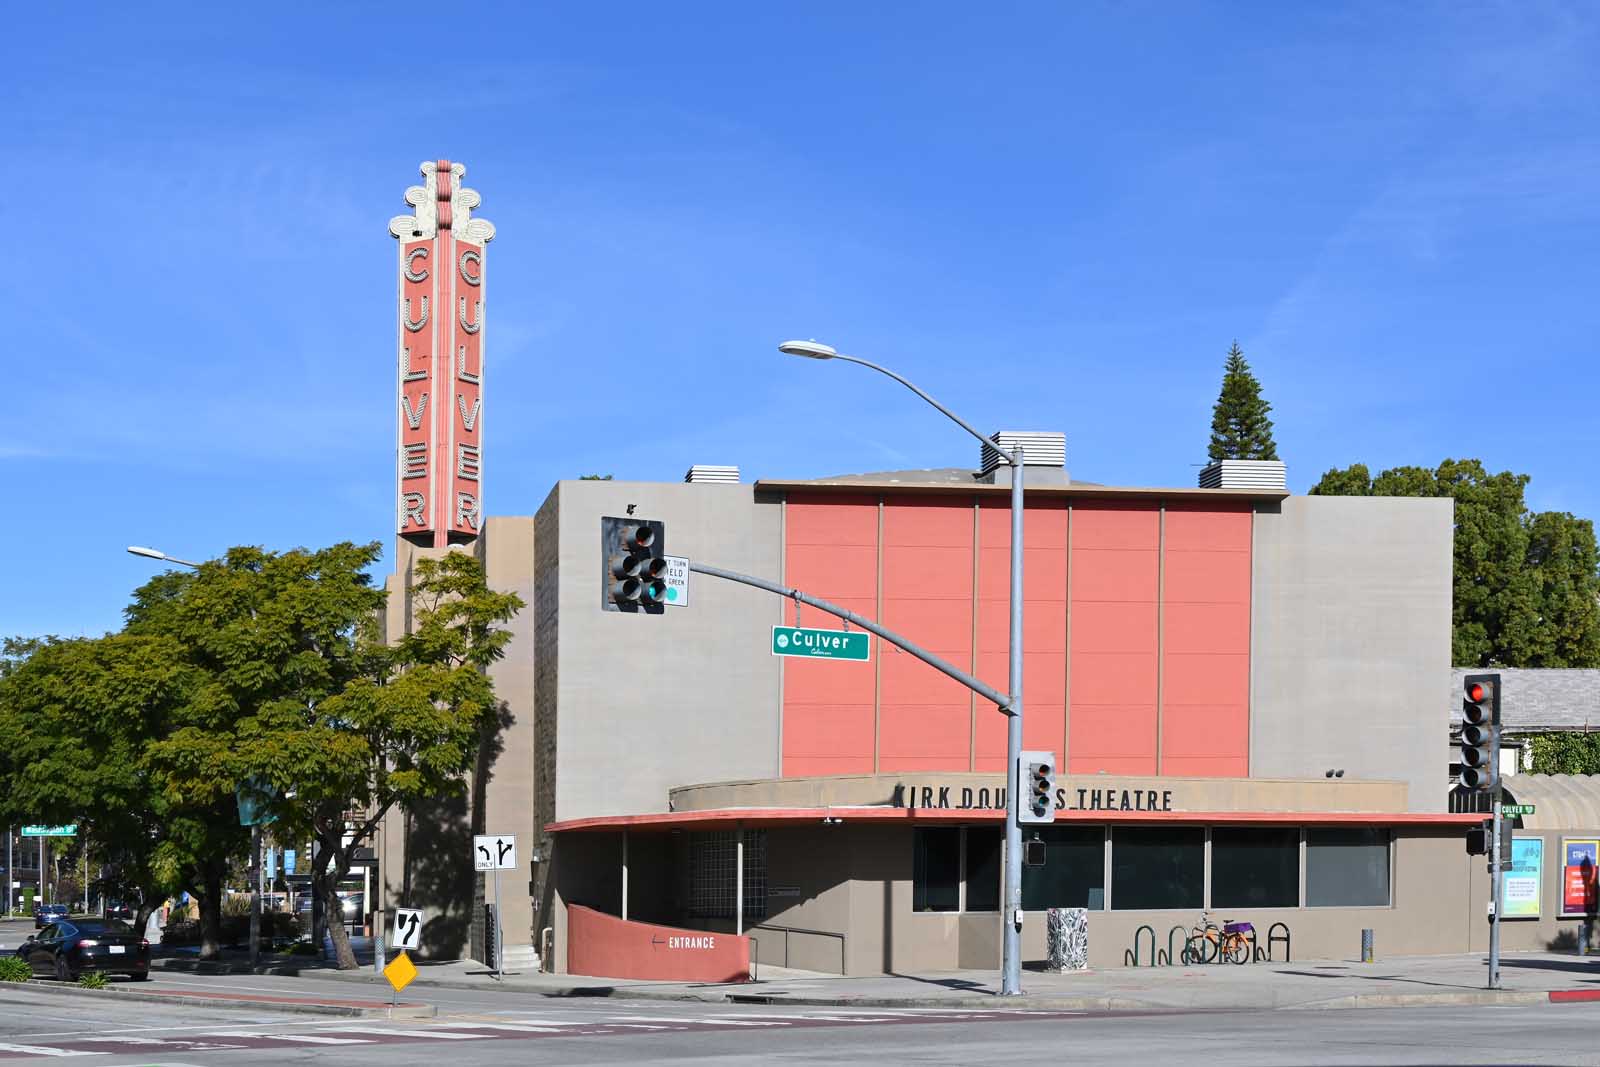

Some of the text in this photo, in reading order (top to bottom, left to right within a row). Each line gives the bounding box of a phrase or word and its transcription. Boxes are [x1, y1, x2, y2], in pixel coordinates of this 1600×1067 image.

[403, 247, 429, 527] CULVER
[456, 250, 481, 529] CULVER
[666, 568, 683, 577] IELD
[792, 631, 849, 649] Culver
[894, 786, 1172, 812] KIRK DOUS THEATRE
[669, 936, 715, 949] ENTRANCE
